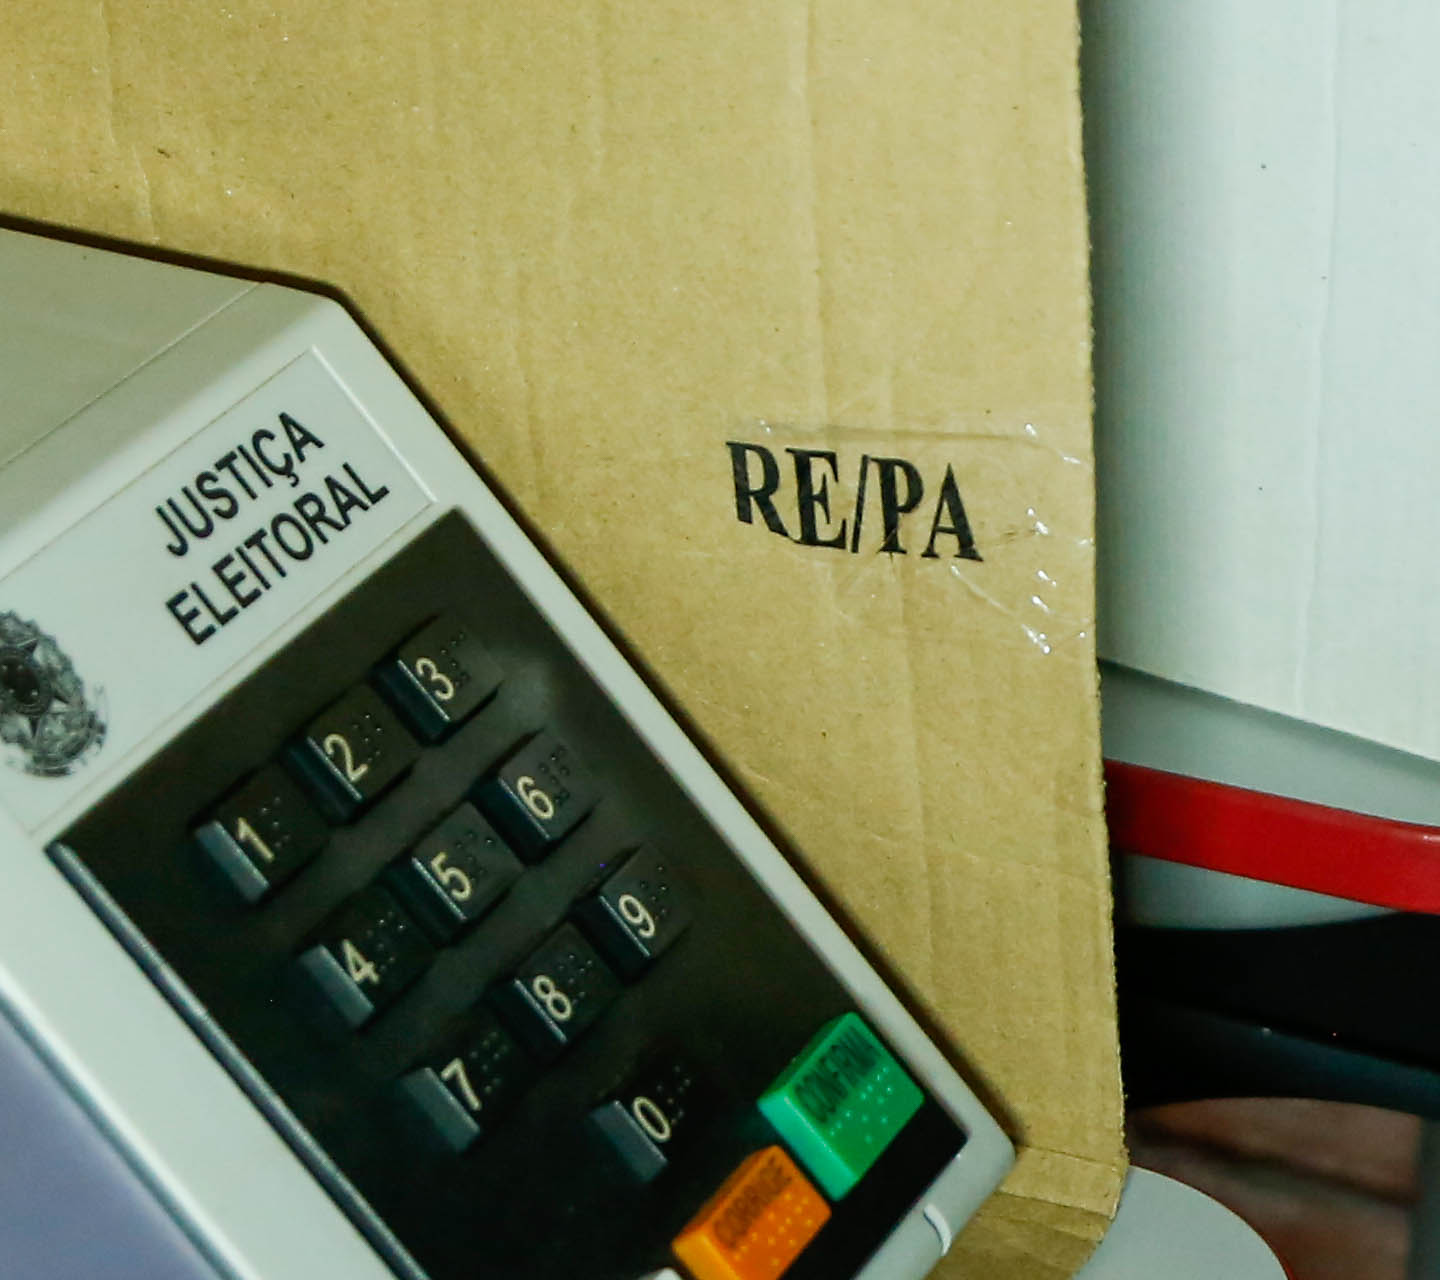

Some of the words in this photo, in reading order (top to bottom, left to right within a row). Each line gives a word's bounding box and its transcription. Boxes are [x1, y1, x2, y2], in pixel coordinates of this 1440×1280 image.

[154, 411, 326, 558] JUSTIÇA
[165, 461, 391, 646] ELEITORAL
[725, 439, 984, 562] RE/PA
[235, 817, 275, 863] 1
[326, 732, 368, 784] 2
[415, 656, 456, 703] 3
[341, 935, 381, 986] 4
[433, 850, 474, 901] 5
[516, 775, 556, 821] 6
[439, 1056, 484, 1112] 7
[532, 973, 574, 1022] 8
[620, 892, 657, 940] 9
[633, 1094, 673, 1144] 0
